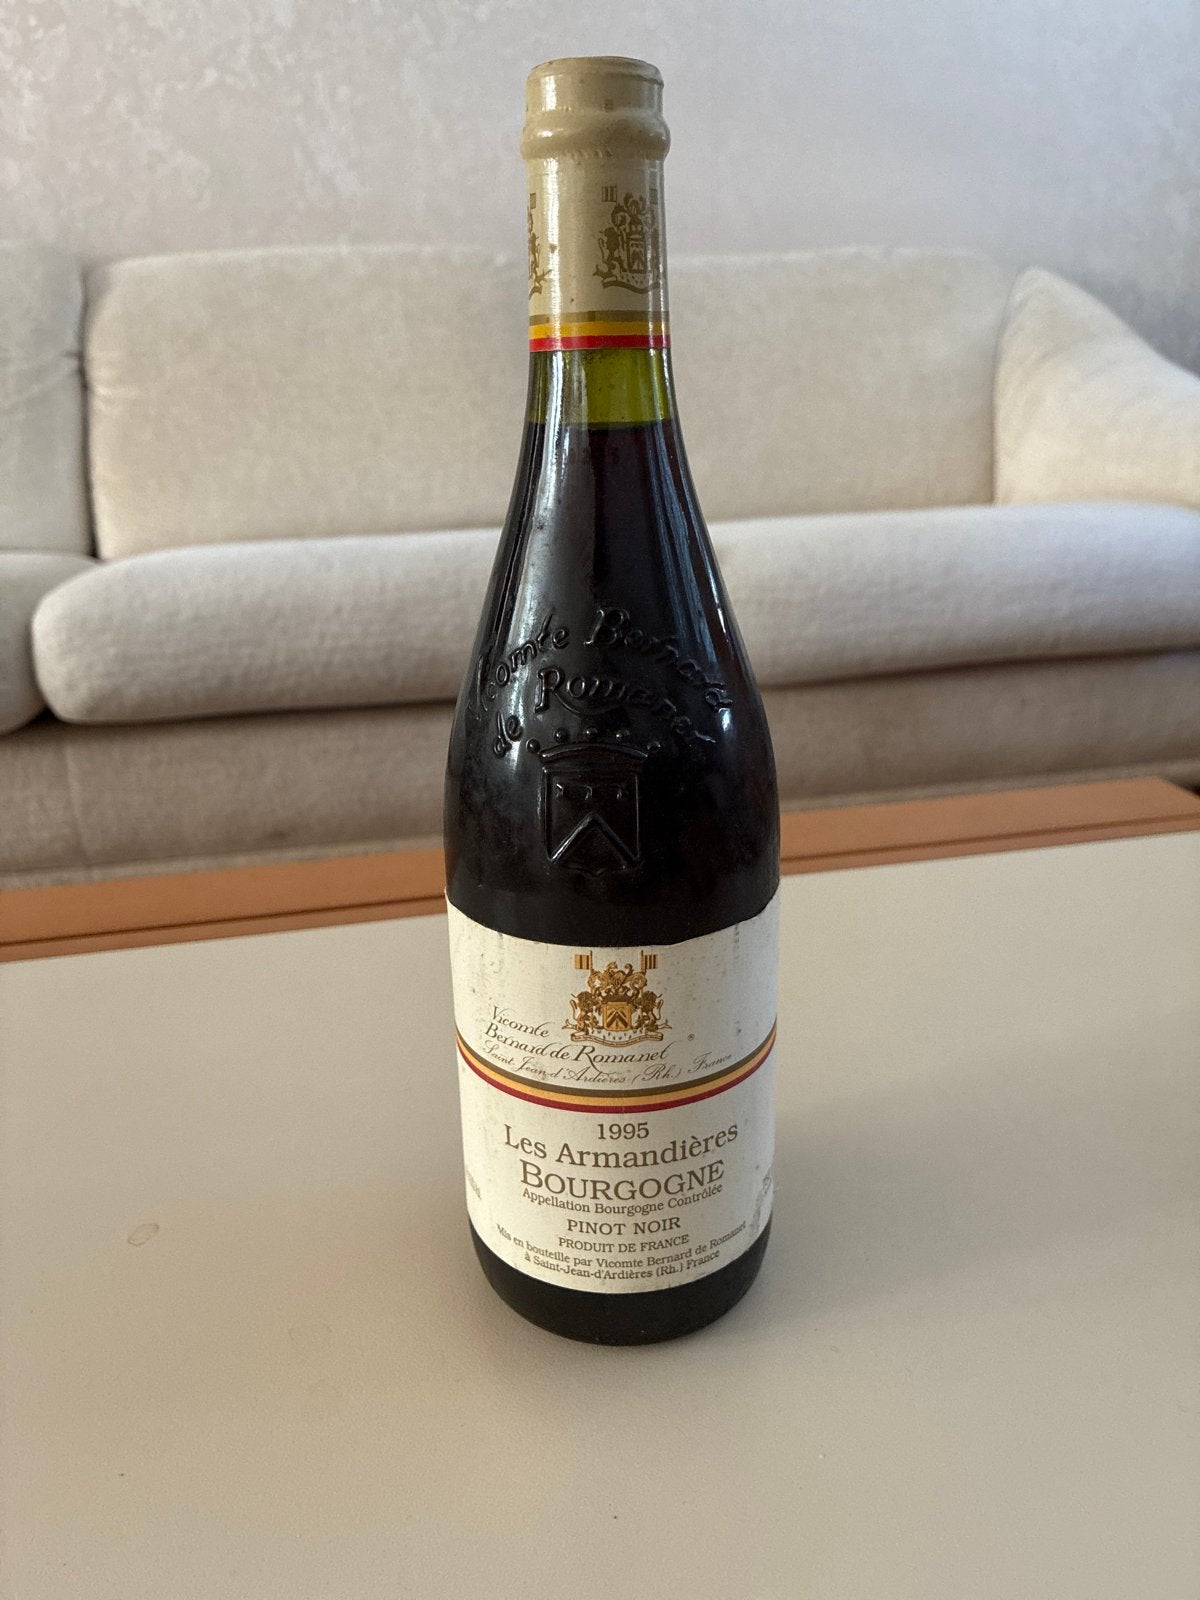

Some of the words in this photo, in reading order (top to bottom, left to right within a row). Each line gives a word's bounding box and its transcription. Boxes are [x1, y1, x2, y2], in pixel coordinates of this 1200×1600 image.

[493, 711, 524, 757] de
[492, 1006, 553, 1038] Vicomte
[484, 1022, 558, 1057] Bernard
[550, 1043, 574, 1060] de
[572, 1040, 676, 1075] Romanet
[631, 1063, 681, 1083] (Rh.)
[688, 1051, 732, 1073] France
[504, 1123, 548, 1159] Les
[555, 1123, 738, 1169] Armandières
[597, 1121, 650, 1140] 1995
[519, 1158, 725, 1201] BOURGOGNE
[522, 1187, 591, 1213] Appellation
[594, 1202, 665, 1217] Bourgogne
[667, 1183, 723, 1209] Contrôlée
[566, 1218, 626, 1236] PINOT
[633, 1216, 682, 1235] NOIR
[496, 1223, 512, 1241] Mis
[513, 1237, 525, 1248] en
[526, 1240, 571, 1263] bouteille
[573, 1256, 593, 1267] par
[596, 1257, 644, 1269] Vicomte
[646, 1248, 693, 1267] Bernard
[694, 1244, 707, 1256] de
[709, 1220, 746, 1249] Romanet
[558, 1236, 615, 1254] PRODUIT
[618, 1242, 637, 1253] DE
[640, 1233, 690, 1252] FRANCE
[524, 1251, 532, 1262] à
[533, 1255, 653, 1280] Saint-Jean-d'Ardières
[656, 1261, 684, 1278] (Rh.)
[686, 1249, 720, 1270] France
